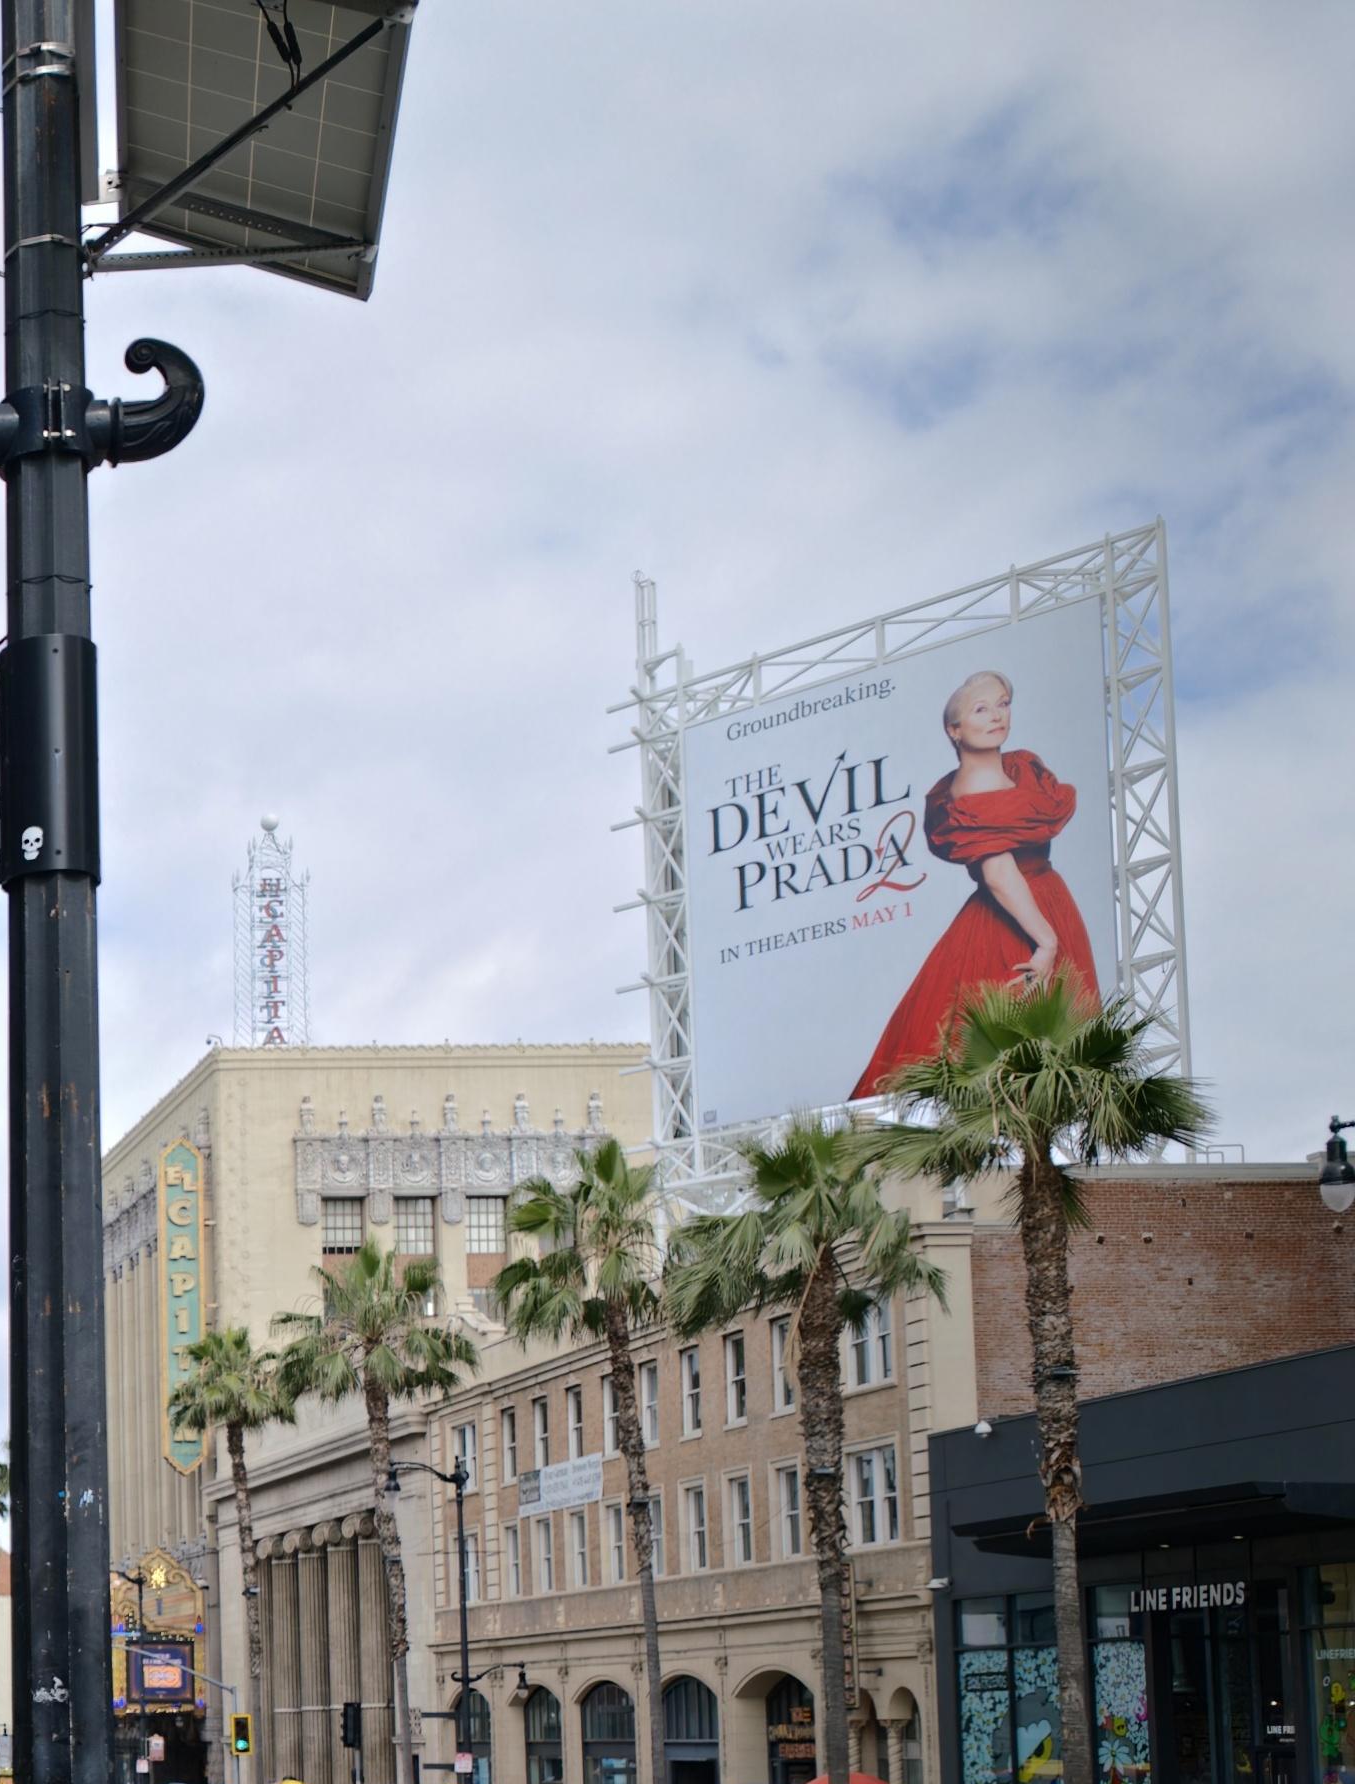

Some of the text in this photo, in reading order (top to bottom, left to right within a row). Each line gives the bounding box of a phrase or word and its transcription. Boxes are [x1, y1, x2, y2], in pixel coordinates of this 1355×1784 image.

[726, 677, 896, 741] Groundbreaking.
[707, 749, 912, 856] DEVIL
[725, 763, 783, 799] THE
[765, 817, 862, 862] WEARS
[734, 832, 914, 913] PRADA
[719, 901, 914, 965] IN THEATERS MAY 1
[263, 899, 288, 1046] CAPITA
[165, 1163, 198, 1193] EL
[167, 1198, 201, 1444] CAPIT
[1130, 1581, 1246, 1613] LINE FRIENDS
